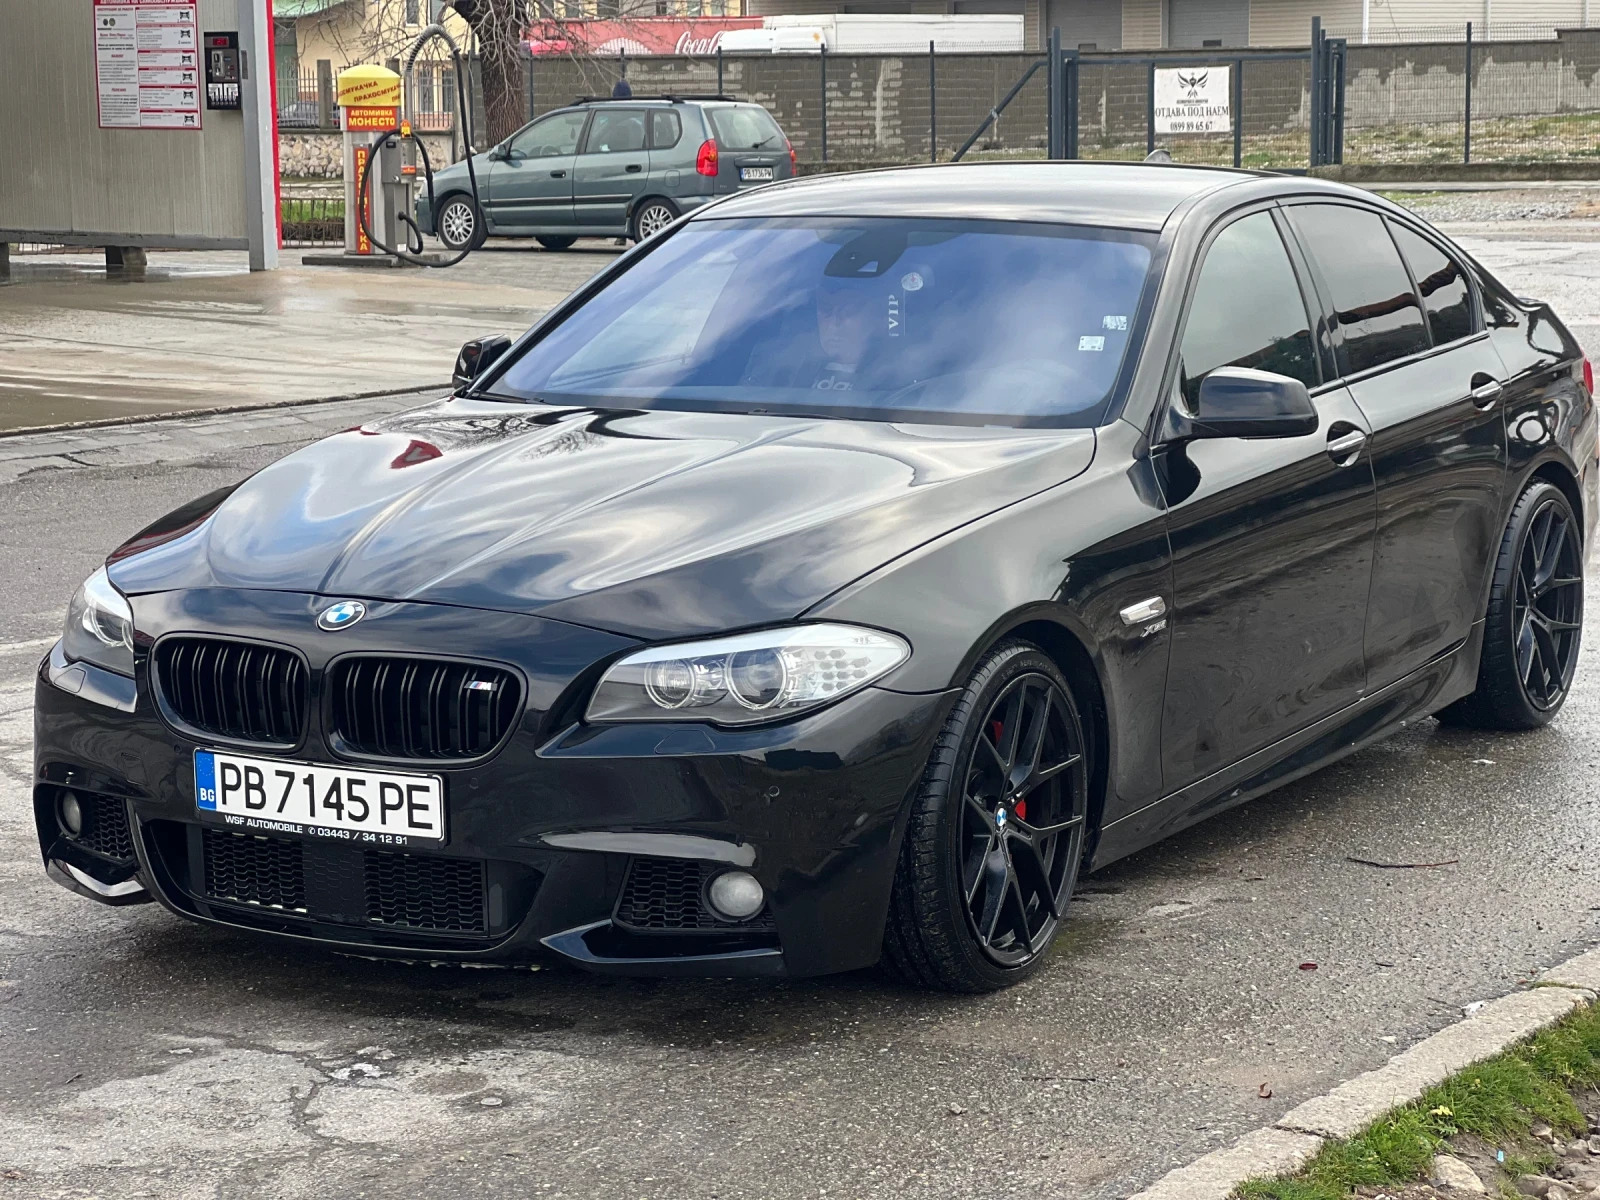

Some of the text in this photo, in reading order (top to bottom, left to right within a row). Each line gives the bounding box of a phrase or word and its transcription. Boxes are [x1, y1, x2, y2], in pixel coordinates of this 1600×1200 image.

[1155, 105, 1229, 118] ОТДАВА ПОД НАЕМ
[348, 117, 396, 126] МОНЕСТО
[1170, 122, 1186, 132] 0899
[1186, 121, 1195, 131] 89
[200, 787, 216, 802] BG
[220, 761, 434, 831] PB 7145 PE
[224, 814, 246, 826] WSF
[247, 818, 303, 834] AUTOMOBILE
[317, 827, 350, 840] 03443
[362, 832, 376, 843] 34
[380, 834, 393, 845] 12
[396, 836, 408, 846] 91
